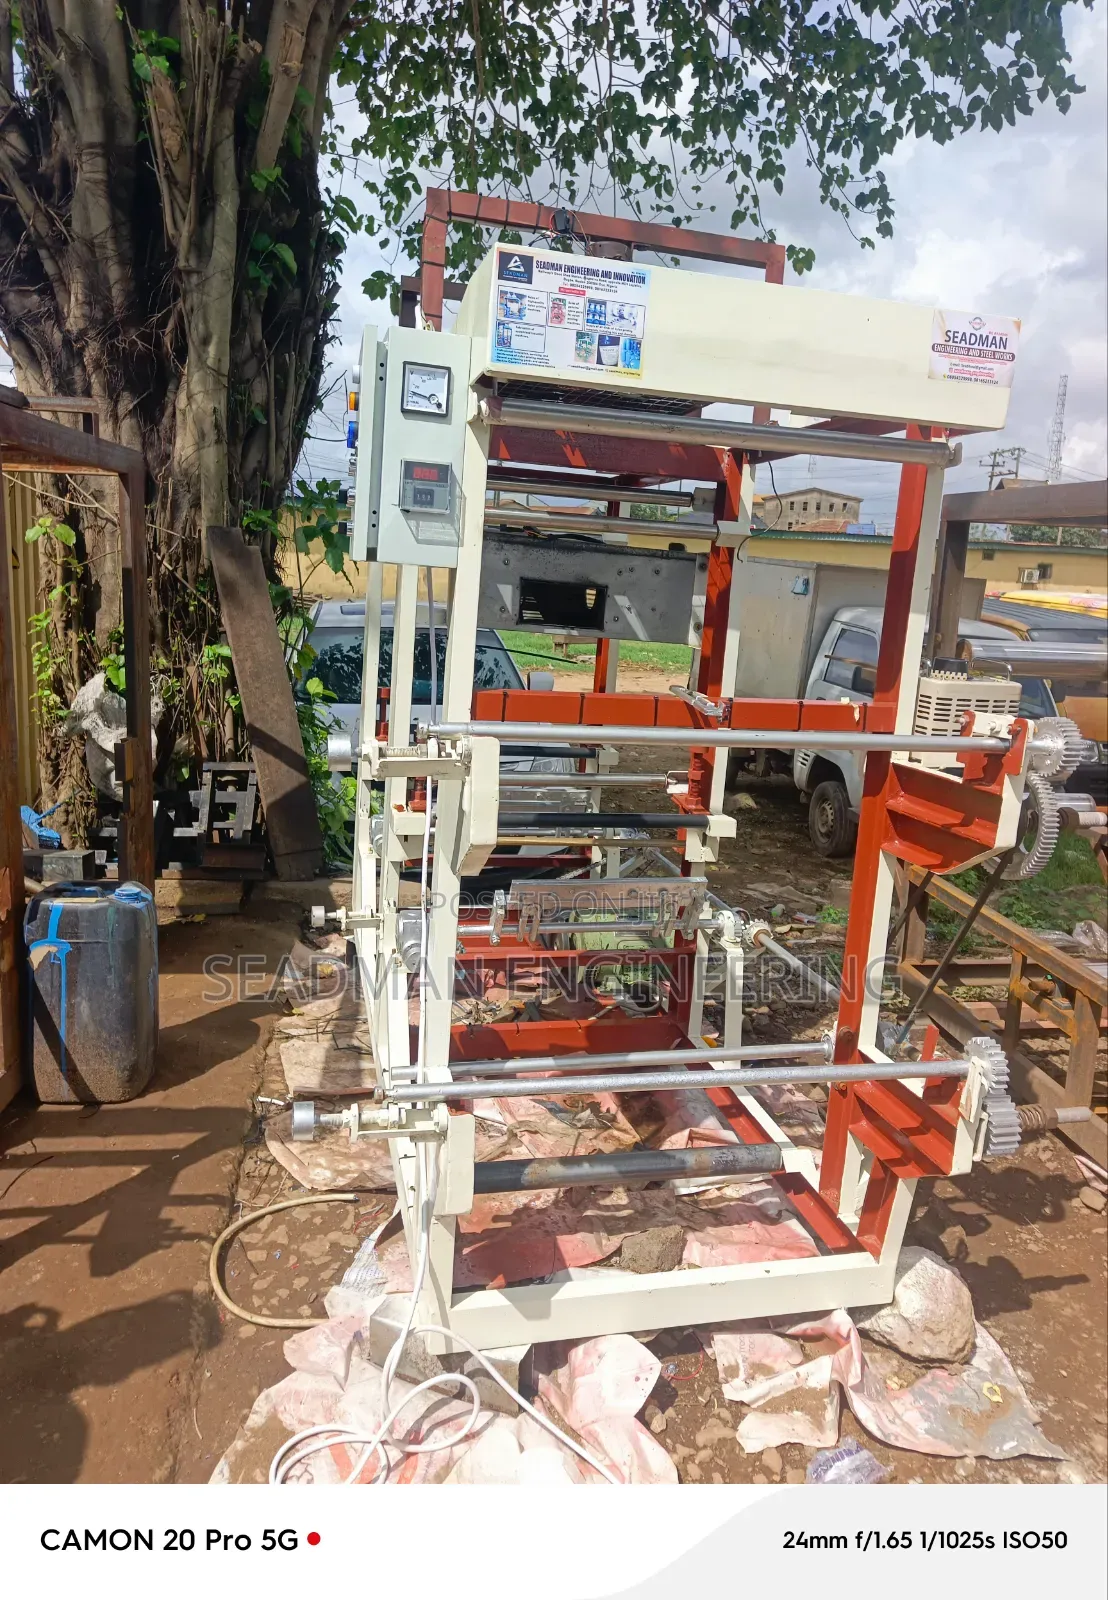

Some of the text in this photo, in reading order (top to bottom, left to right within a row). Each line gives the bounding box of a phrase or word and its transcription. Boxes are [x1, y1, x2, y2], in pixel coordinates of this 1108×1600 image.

[536, 260, 563, 272] SEADMAN
[563, 264, 600, 278] ENGINEERING
[600, 269, 613, 280] AND
[613, 271, 646, 285] INNOVATION
[944, 329, 1008, 350] SEADMAN
[934, 344, 968, 355] ENGINEERING
[968, 349, 980, 357] AND
[980, 350, 994, 359] STEEL
[995, 352, 1013, 361] WORKS
